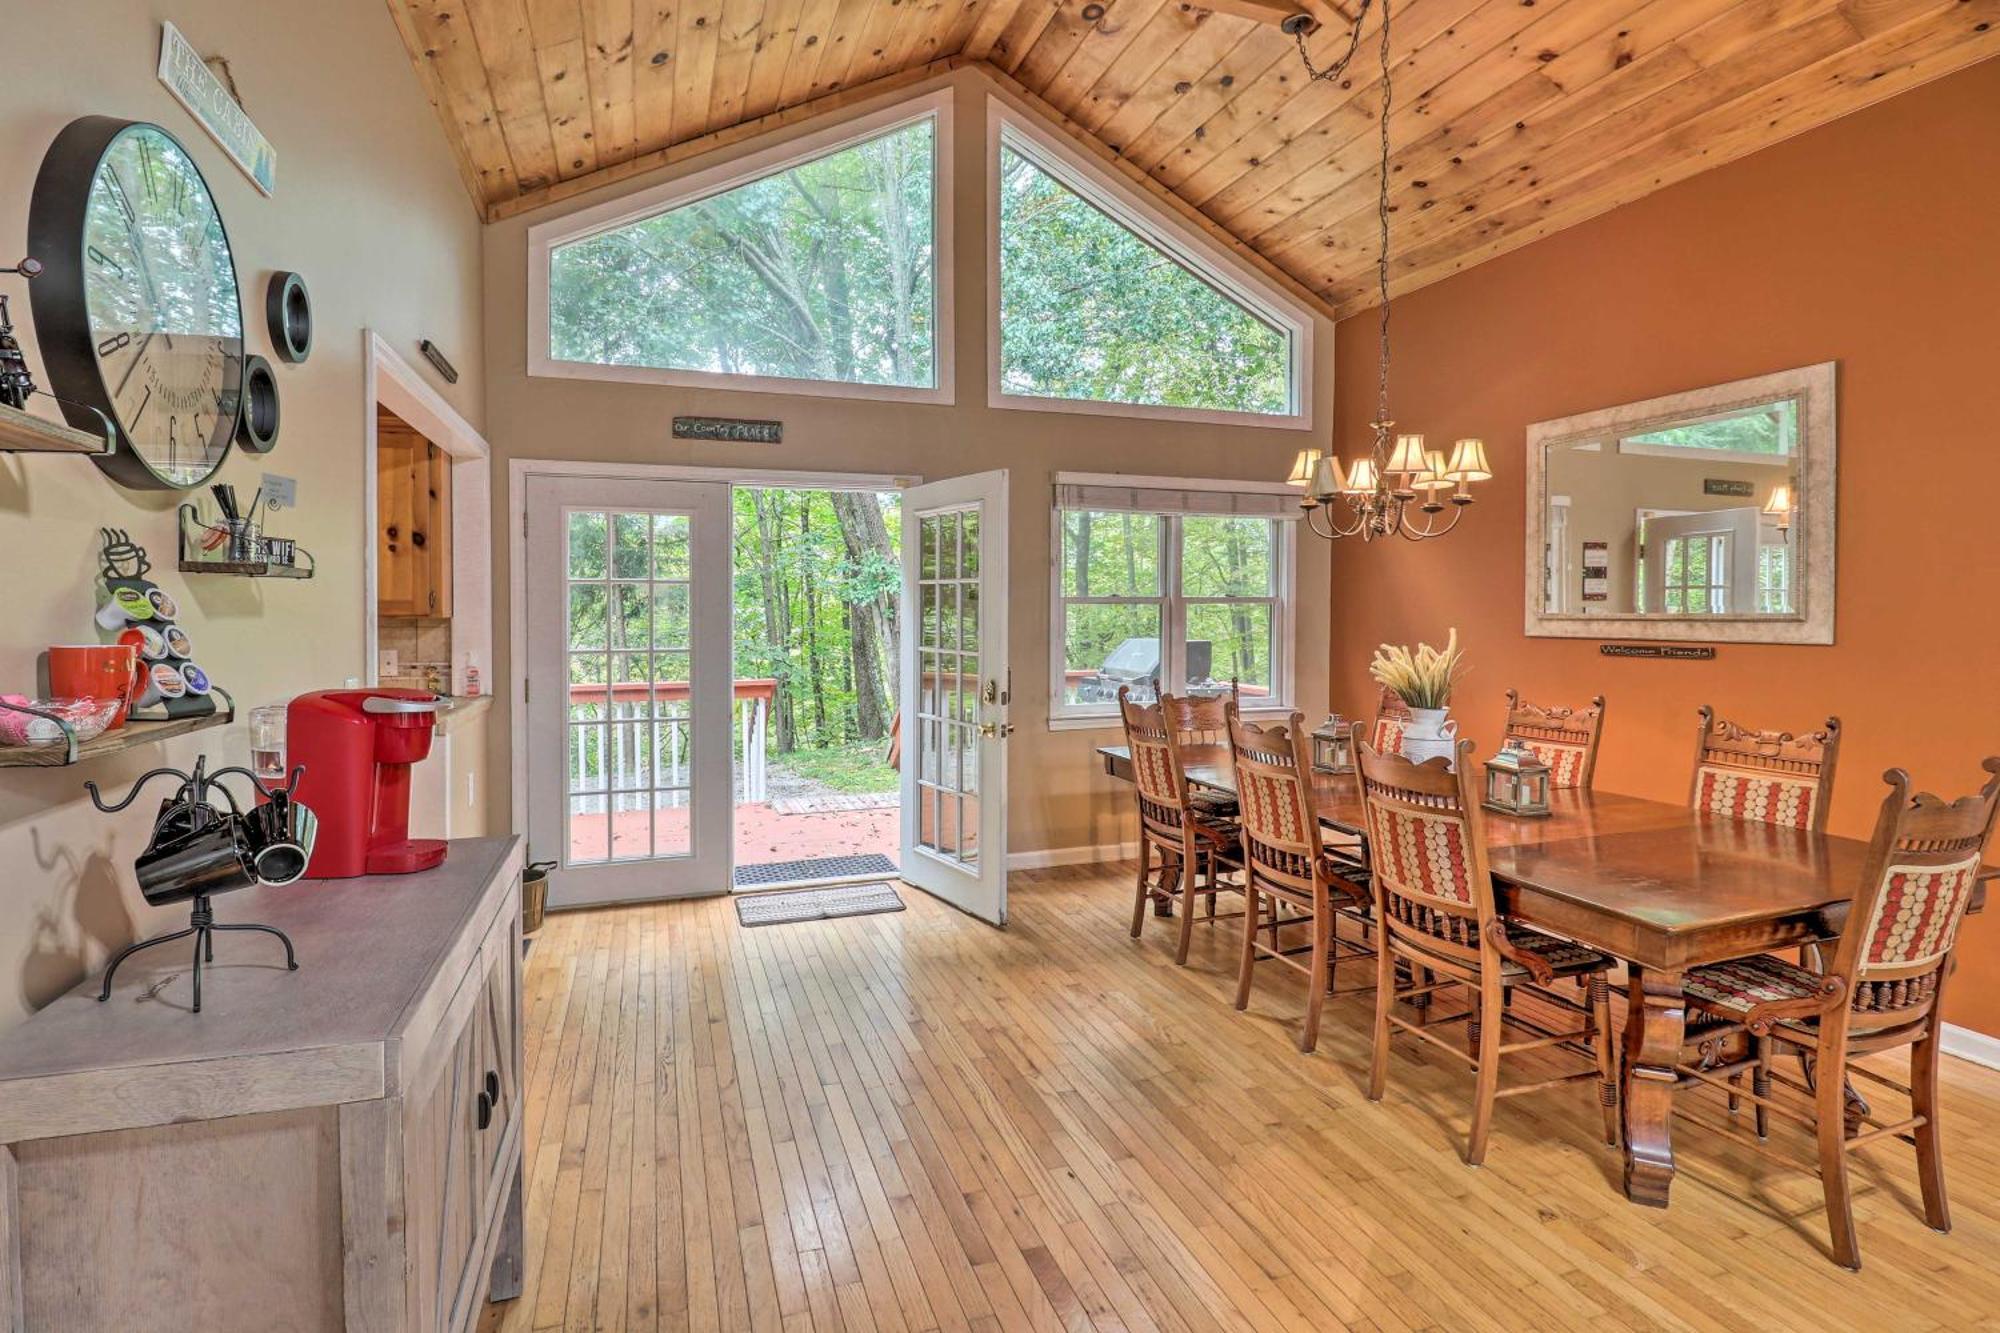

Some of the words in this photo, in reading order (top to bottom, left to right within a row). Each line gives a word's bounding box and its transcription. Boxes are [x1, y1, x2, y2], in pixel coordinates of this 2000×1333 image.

[171, 34, 208, 98] THE
[212, 86, 263, 150] CABIN
[87, 244, 124, 280] 9
[98, 331, 130, 358] 8
[128, 384, 151, 434] 7
[271, 540, 295, 557] WIFI
[1601, 646, 1656, 656] Welcome
